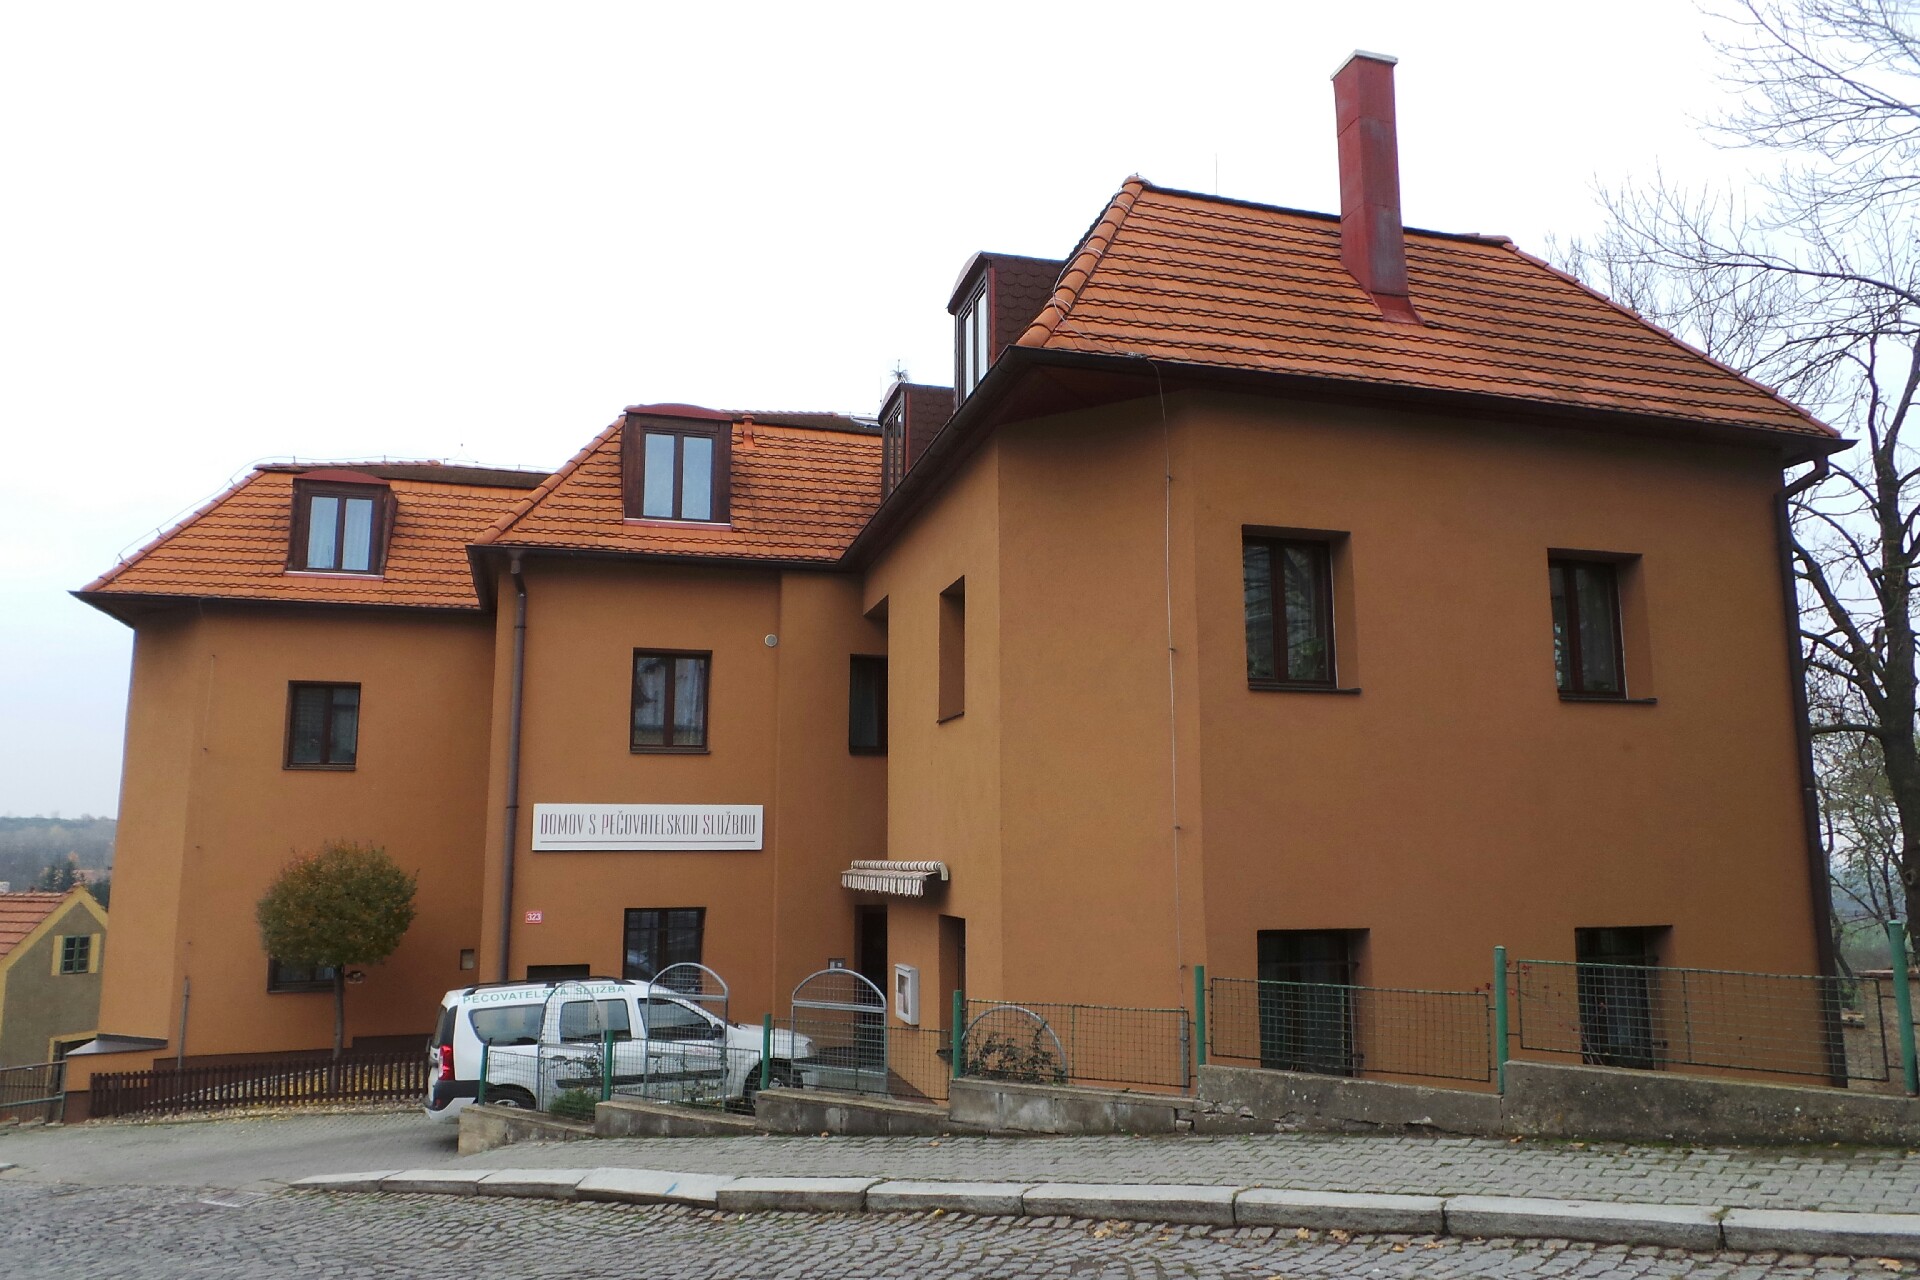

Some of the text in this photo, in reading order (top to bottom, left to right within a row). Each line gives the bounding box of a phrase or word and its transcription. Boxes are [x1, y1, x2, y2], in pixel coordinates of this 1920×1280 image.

[540, 810, 756, 836] DOMOV S PEČOVATELSKOU SLUŽBOU
[527, 913, 541, 921] 323
